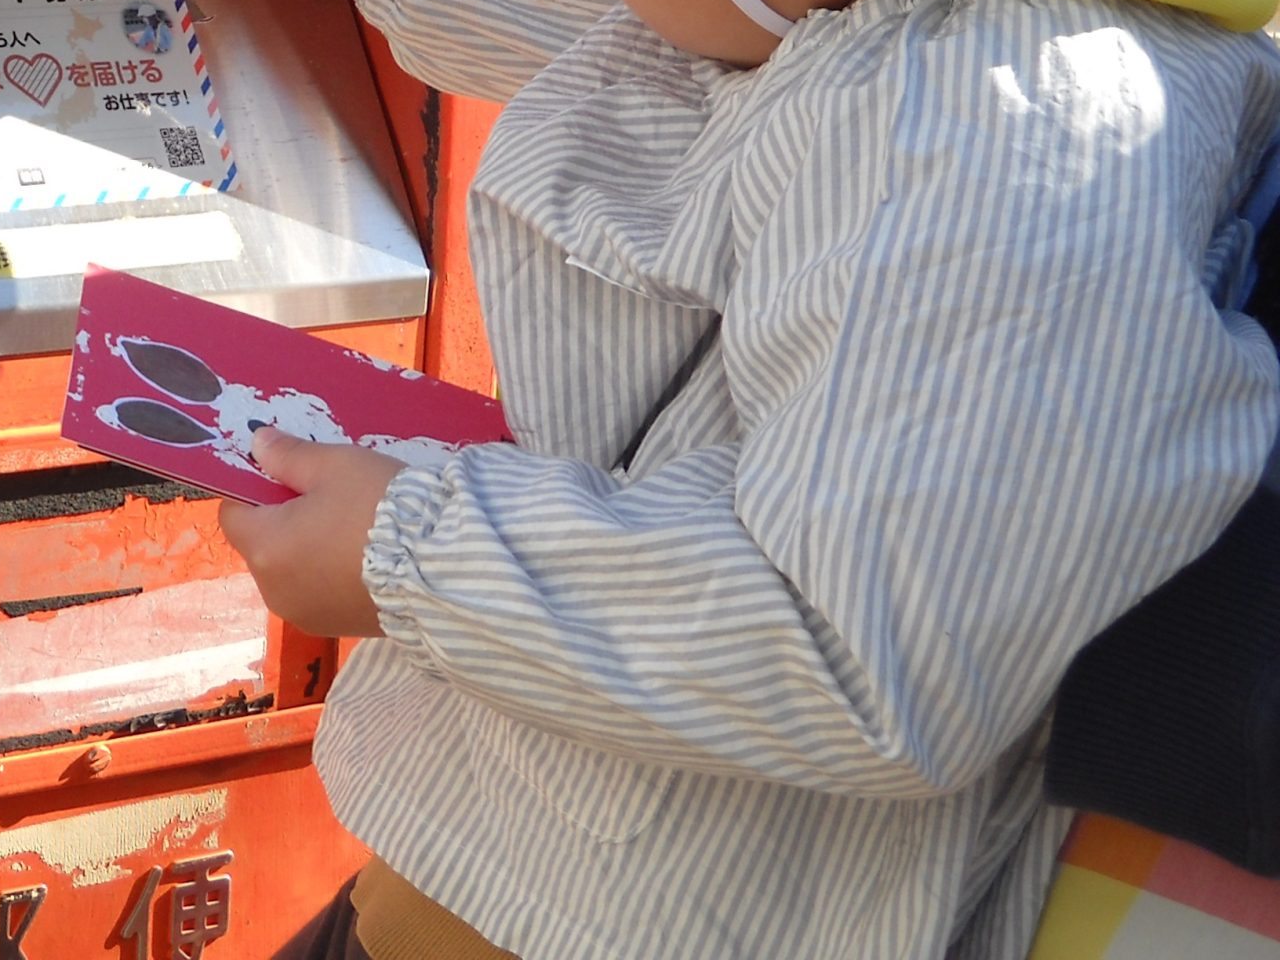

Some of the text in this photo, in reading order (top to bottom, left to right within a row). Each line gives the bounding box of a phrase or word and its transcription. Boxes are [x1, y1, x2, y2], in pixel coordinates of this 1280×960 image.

[66, 59, 163, 88] を届ける
[103, 90, 190, 111] お仕事です!
